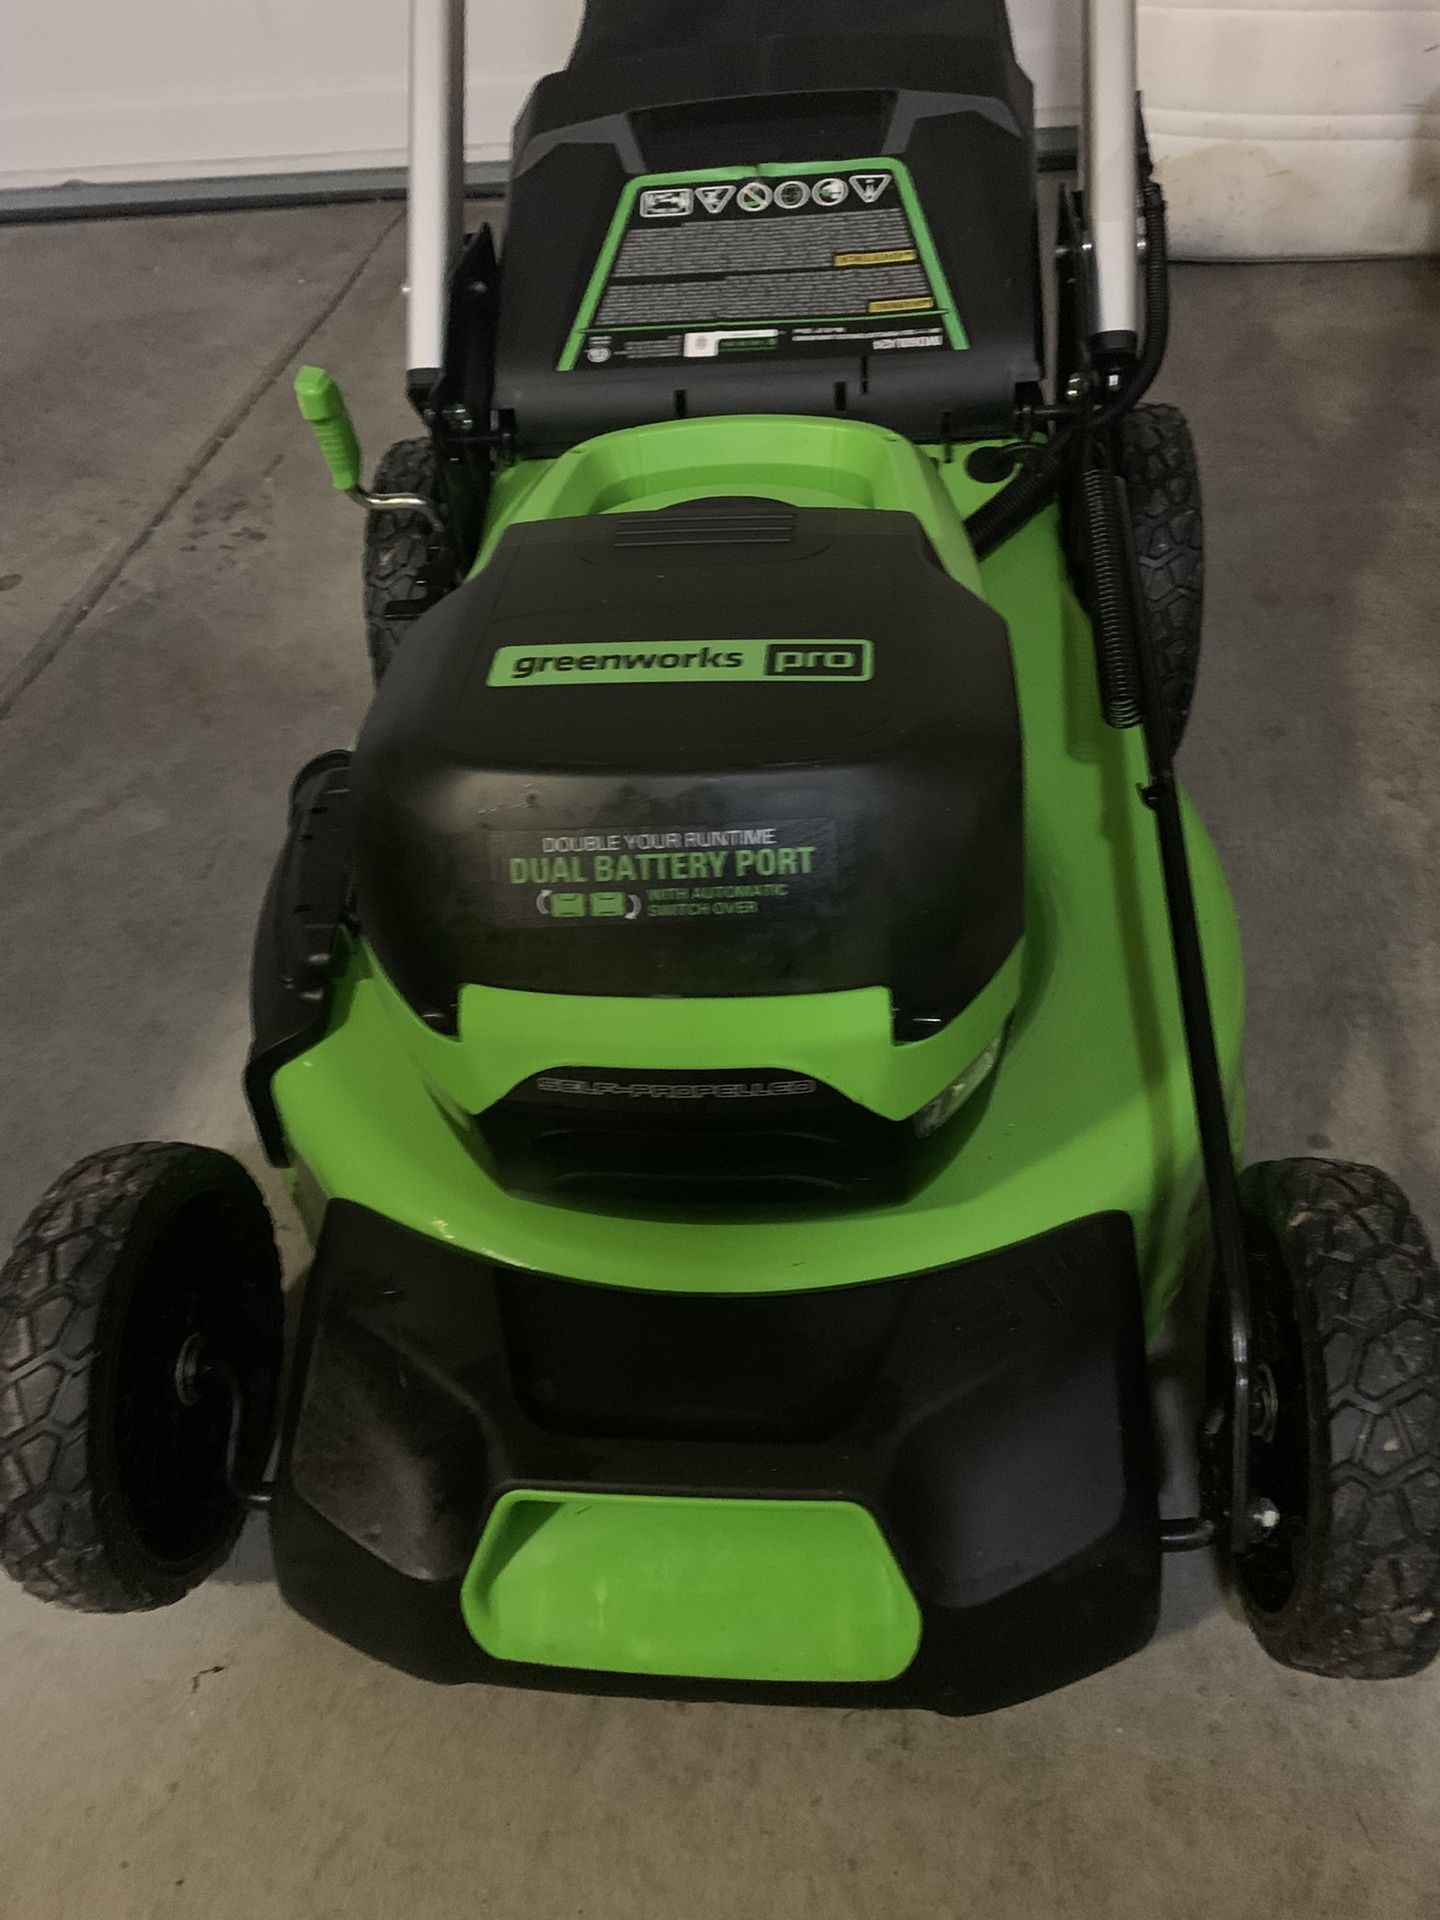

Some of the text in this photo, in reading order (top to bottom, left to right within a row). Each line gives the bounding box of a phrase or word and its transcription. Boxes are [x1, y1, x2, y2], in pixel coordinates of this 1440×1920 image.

[513, 648, 856, 679] greenworks pro
[542, 828, 777, 853] DOUBLE YOUR RUNTIME
[509, 847, 816, 884] DUAL BATTERY PORT
